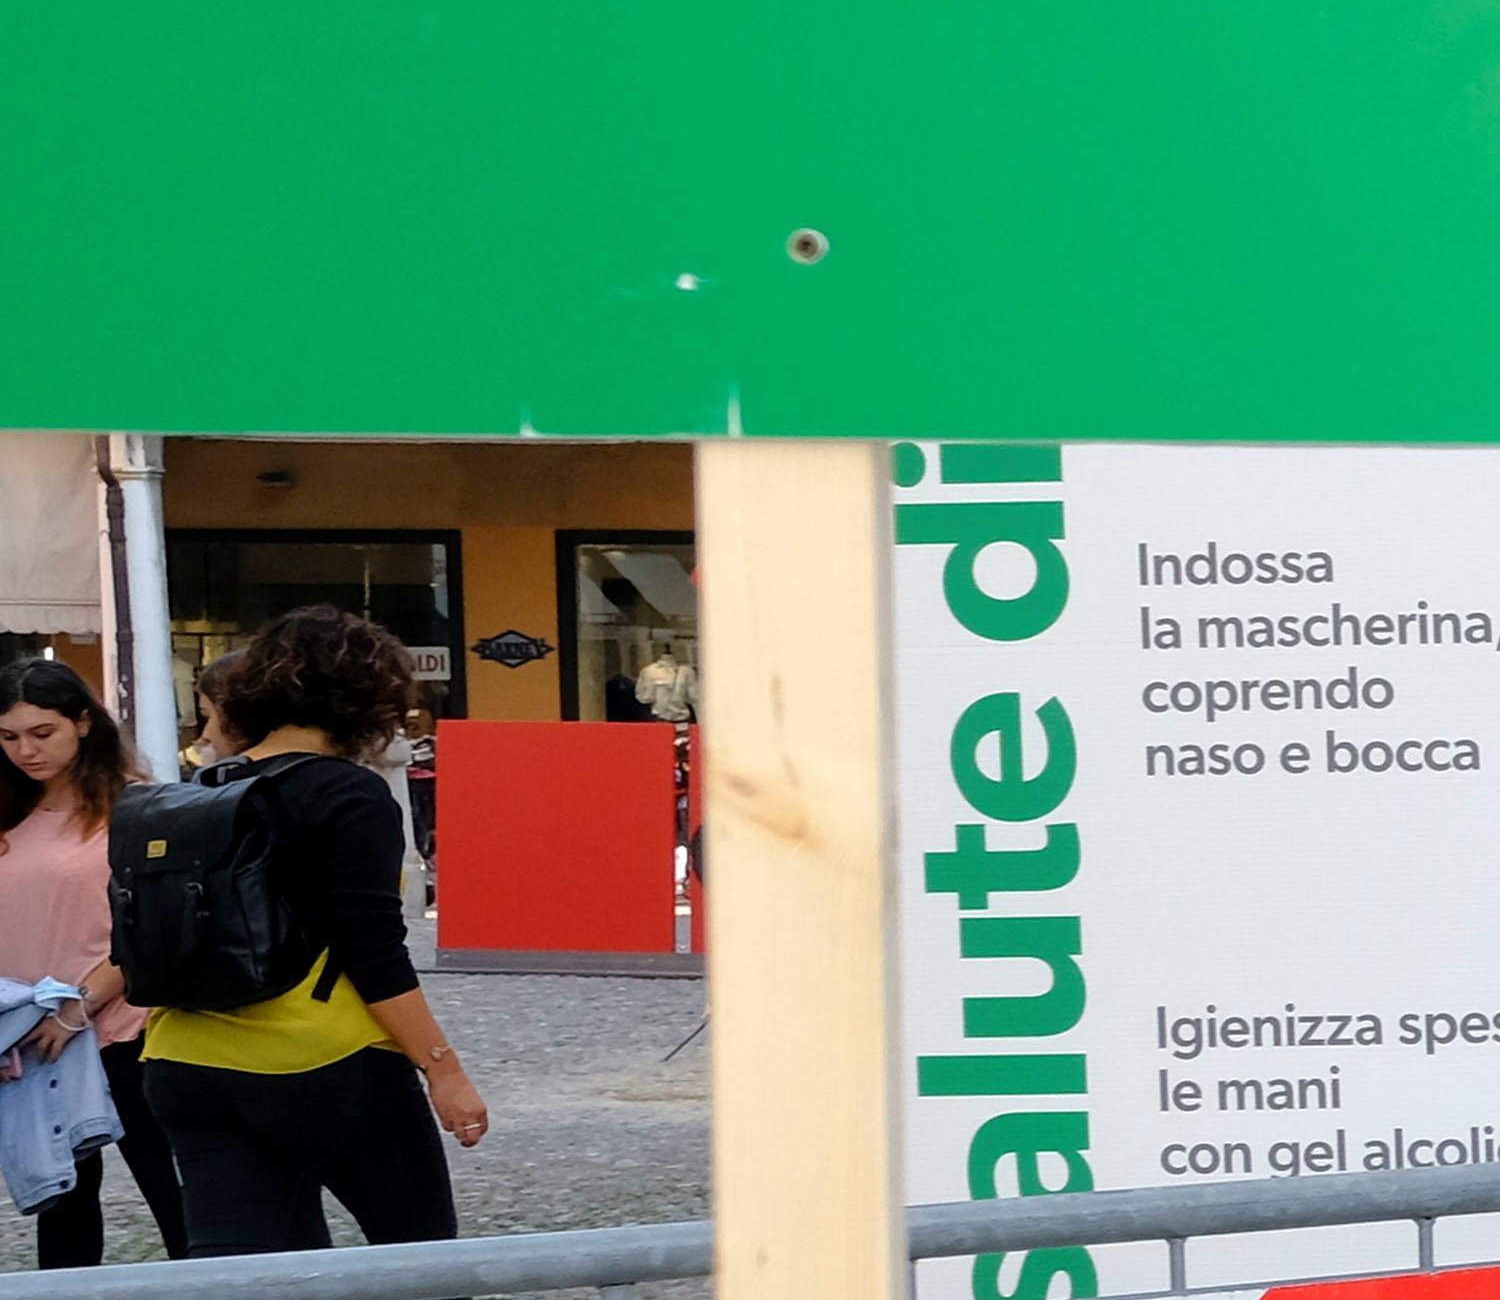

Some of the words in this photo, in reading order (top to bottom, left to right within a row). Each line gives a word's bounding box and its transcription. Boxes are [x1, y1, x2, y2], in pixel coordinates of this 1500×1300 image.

[893, 442, 1071, 643] di
[1137, 544, 1335, 588] Indossa
[1140, 606, 1183, 650] la
[1142, 668, 1396, 719] coprendo
[1144, 737, 1265, 777] naso
[1280, 740, 1310, 774] e
[1327, 729, 1481, 774] bocca
[1157, 1005, 1384, 1060] Igienizza
[1157, 1068, 1202, 1114] le
[1217, 1067, 1341, 1111] mani
[1160, 1140, 1252, 1175] con
[1268, 1129, 1346, 1178] gel
